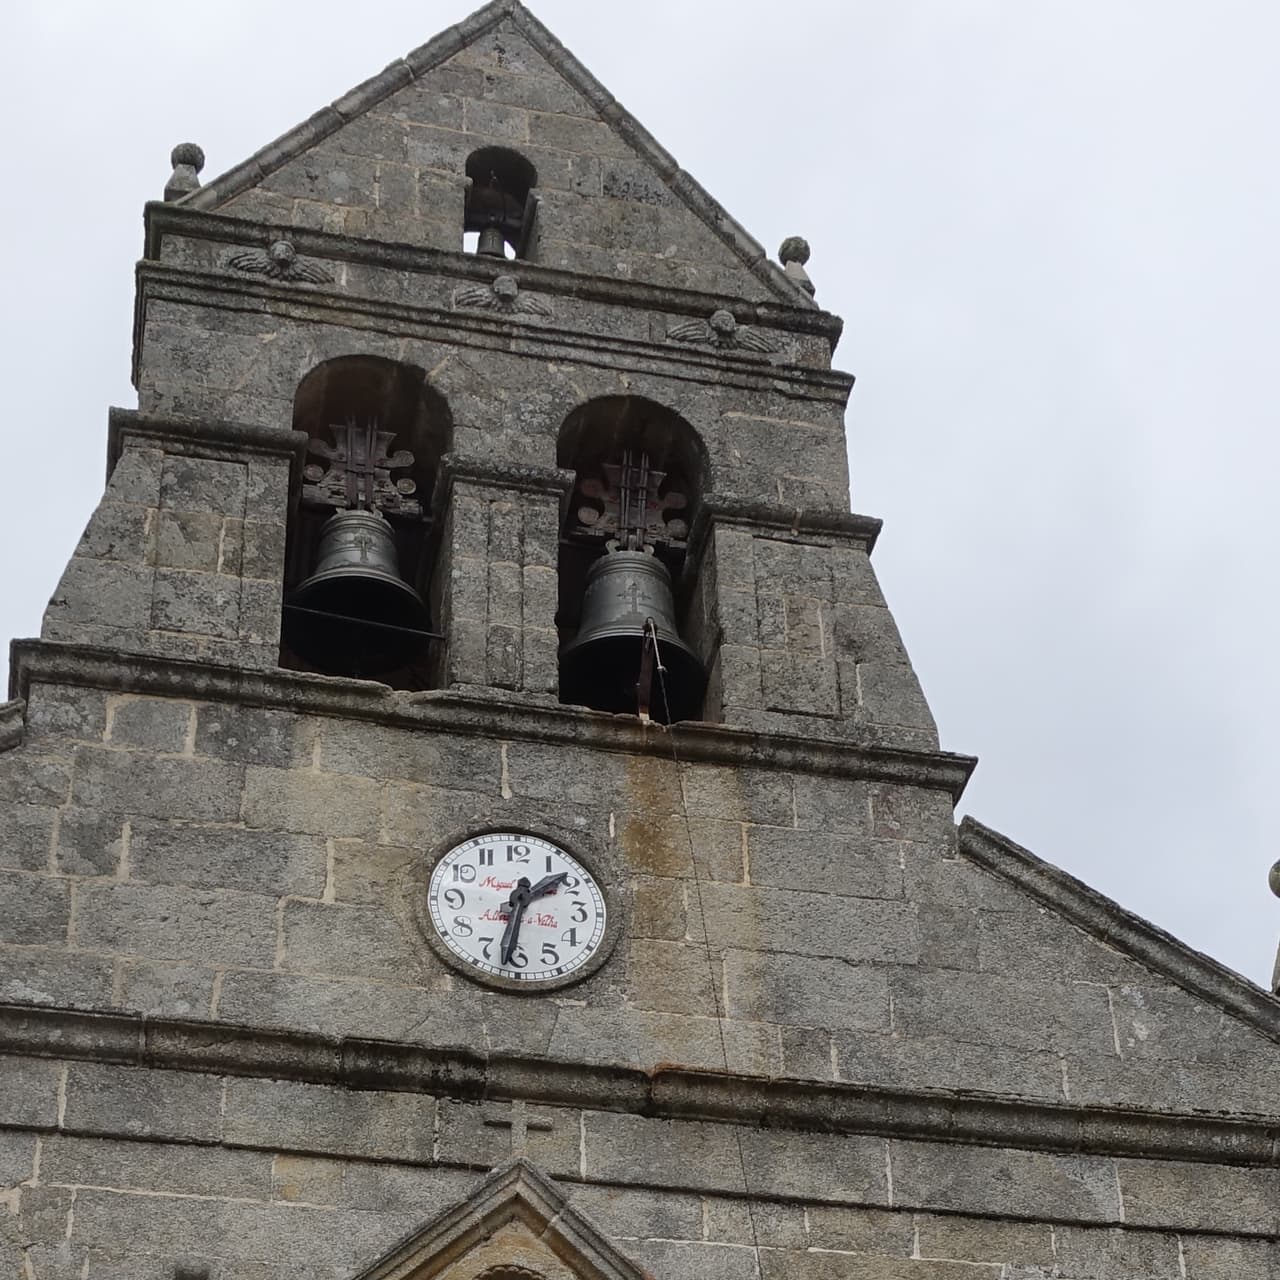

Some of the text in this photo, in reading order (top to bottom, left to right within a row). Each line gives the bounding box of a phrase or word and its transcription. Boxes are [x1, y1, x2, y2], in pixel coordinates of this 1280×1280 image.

[479, 848, 494, 866] 11
[506, 844, 531, 864] 12
[545, 855, 552, 873] 1
[452, 863, 476, 883] 10
[563, 875, 580, 896] 2
[444, 888, 466, 910] 9
[570, 900, 588, 922] 3
[451, 915, 473, 937] 8
[561, 927, 582, 947] 4
[478, 936, 494, 960] 7
[509, 944, 529, 968] 6
[540, 942, 560, 966] 5
